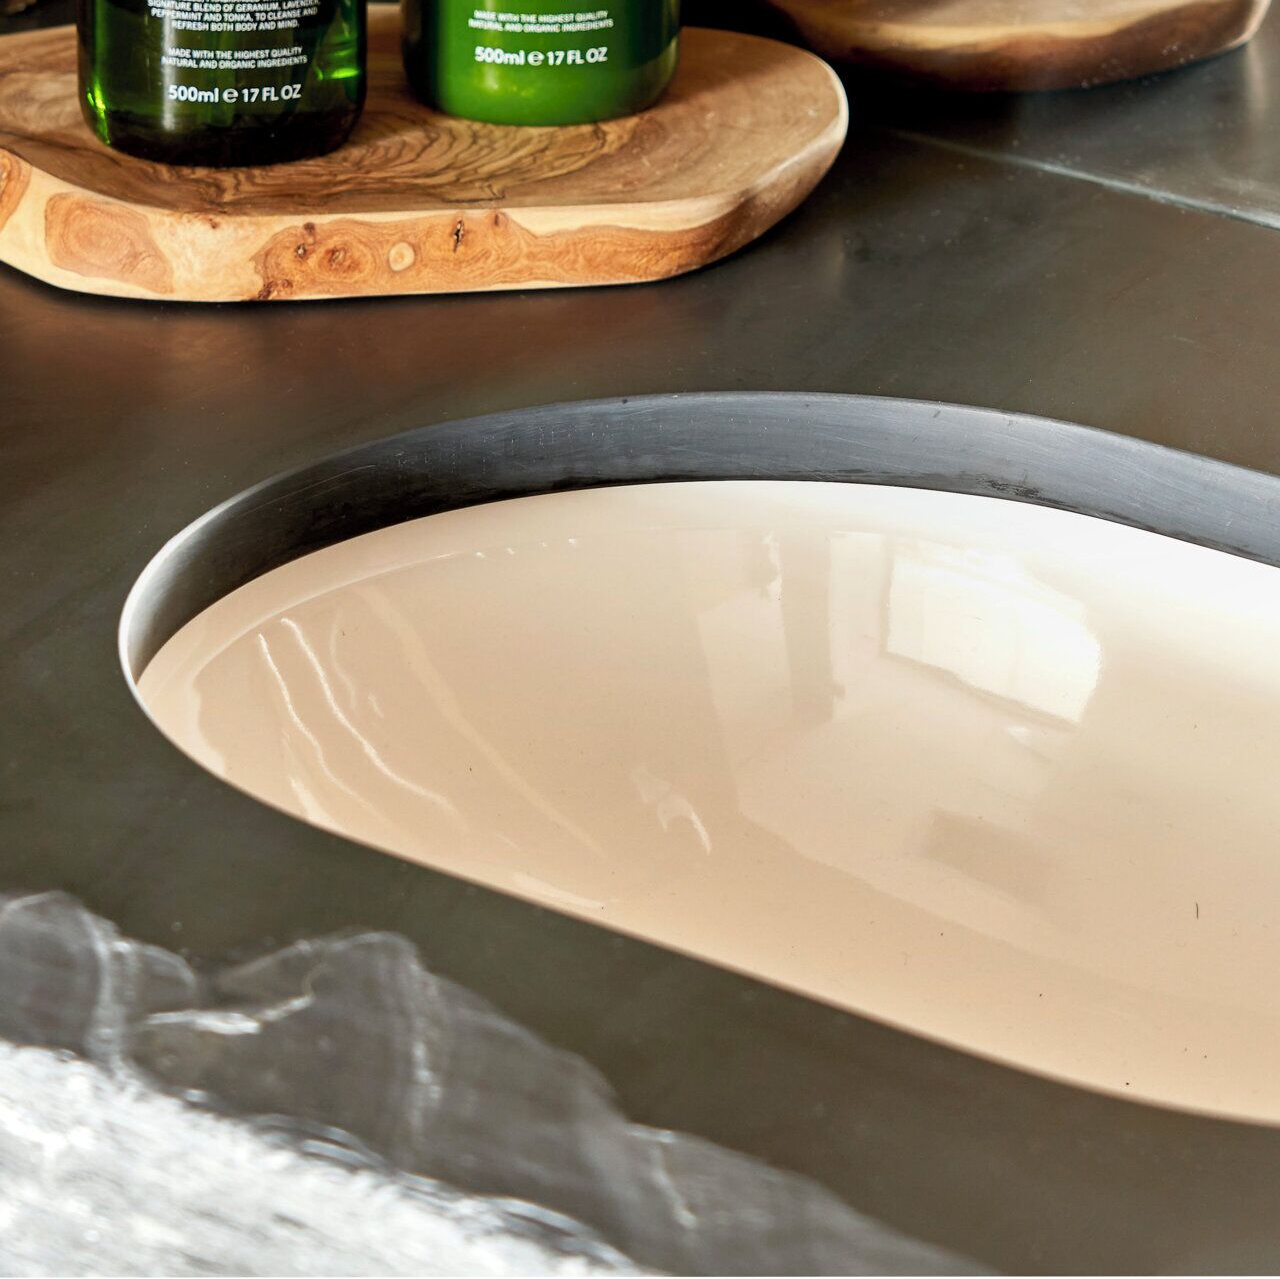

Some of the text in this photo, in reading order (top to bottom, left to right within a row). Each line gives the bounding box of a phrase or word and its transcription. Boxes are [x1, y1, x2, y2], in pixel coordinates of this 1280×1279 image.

[151, 8, 202, 21] PEPPERMINT
[204, 11, 222, 21] AND
[255, 11, 266, 21] TO
[267, 9, 301, 20] CLEANSE
[303, 6, 318, 17] AND
[193, 1, 221, 12] BLEND
[223, 2, 234, 12] OF
[474, 10, 608, 23] MADE WITH THE HIGHEST QUALITY
[171, 19, 209, 31] REFRESH
[210, 21, 234, 32] BOTH
[235, 21, 257, 32] BODY
[258, 20, 276, 31] AND
[469, 18, 613, 33] NATURAL AND ORGANIC INGREDIENTS
[170, 46, 303, 60] MADE WITH THE HIGHEST QUALITY
[475, 46, 524, 65] 500ml
[547, 51, 564, 65] 17
[566, 50, 584, 64] FL
[586, 47, 608, 63] OZ
[161, 55, 308, 69] NATURAL AND ORGANIC INGREDIENTS
[169, 84, 219, 103] 500ml
[242, 87, 260, 102] 17
[262, 86, 279, 102] FL
[280, 83, 302, 100] OZ
